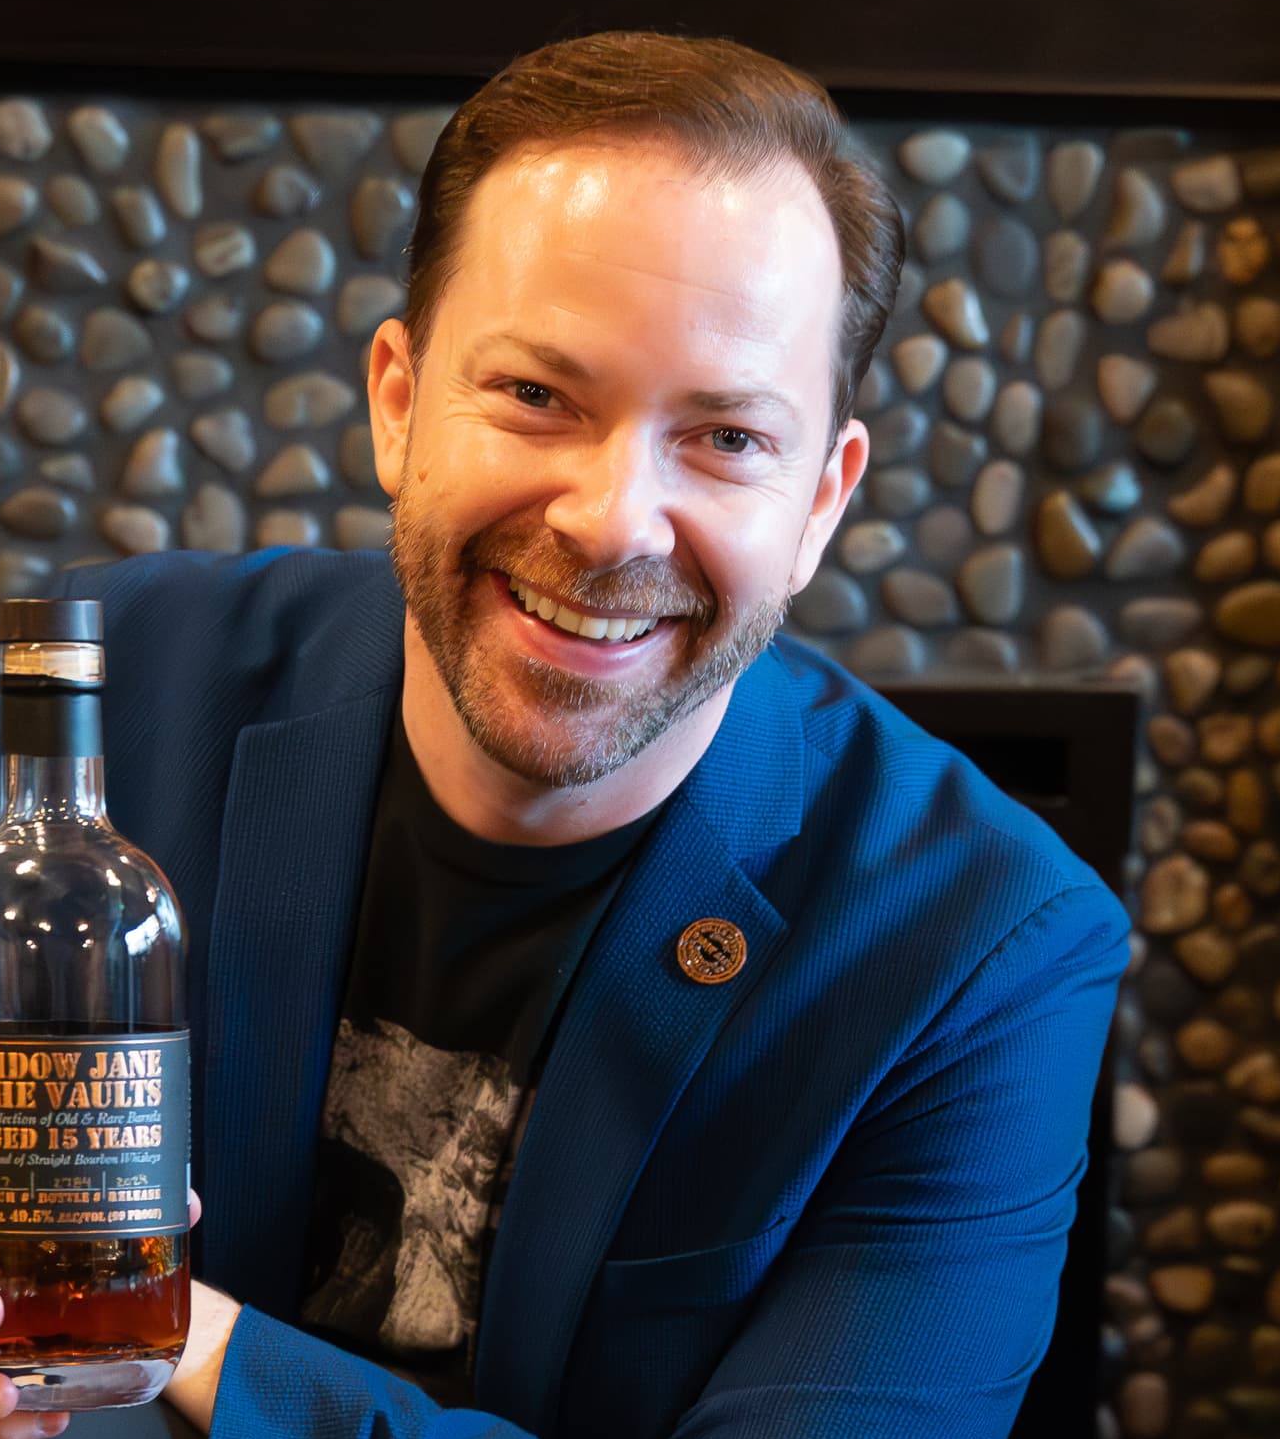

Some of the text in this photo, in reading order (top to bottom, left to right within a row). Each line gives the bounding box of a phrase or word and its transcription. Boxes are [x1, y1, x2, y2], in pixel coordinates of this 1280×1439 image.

[89, 1049, 162, 1079] JANE
[45, 1079, 162, 1110] VAULTS
[40, 1112, 52, 1127] of
[55, 1112, 78, 1125] Old
[97, 1111, 126, 1124] Rare
[48, 1127, 79, 1150] 15
[86, 1124, 162, 1150] YEARS
[14, 1152, 26, 1168] of
[27, 1152, 71, 1168] Straight
[74, 1152, 118, 1165] Bourbon
[38, 1191, 89, 1204] BOTTLE
[108, 1188, 161, 1203] RELEASE
[9, 1209, 54, 1223] 49.5%
